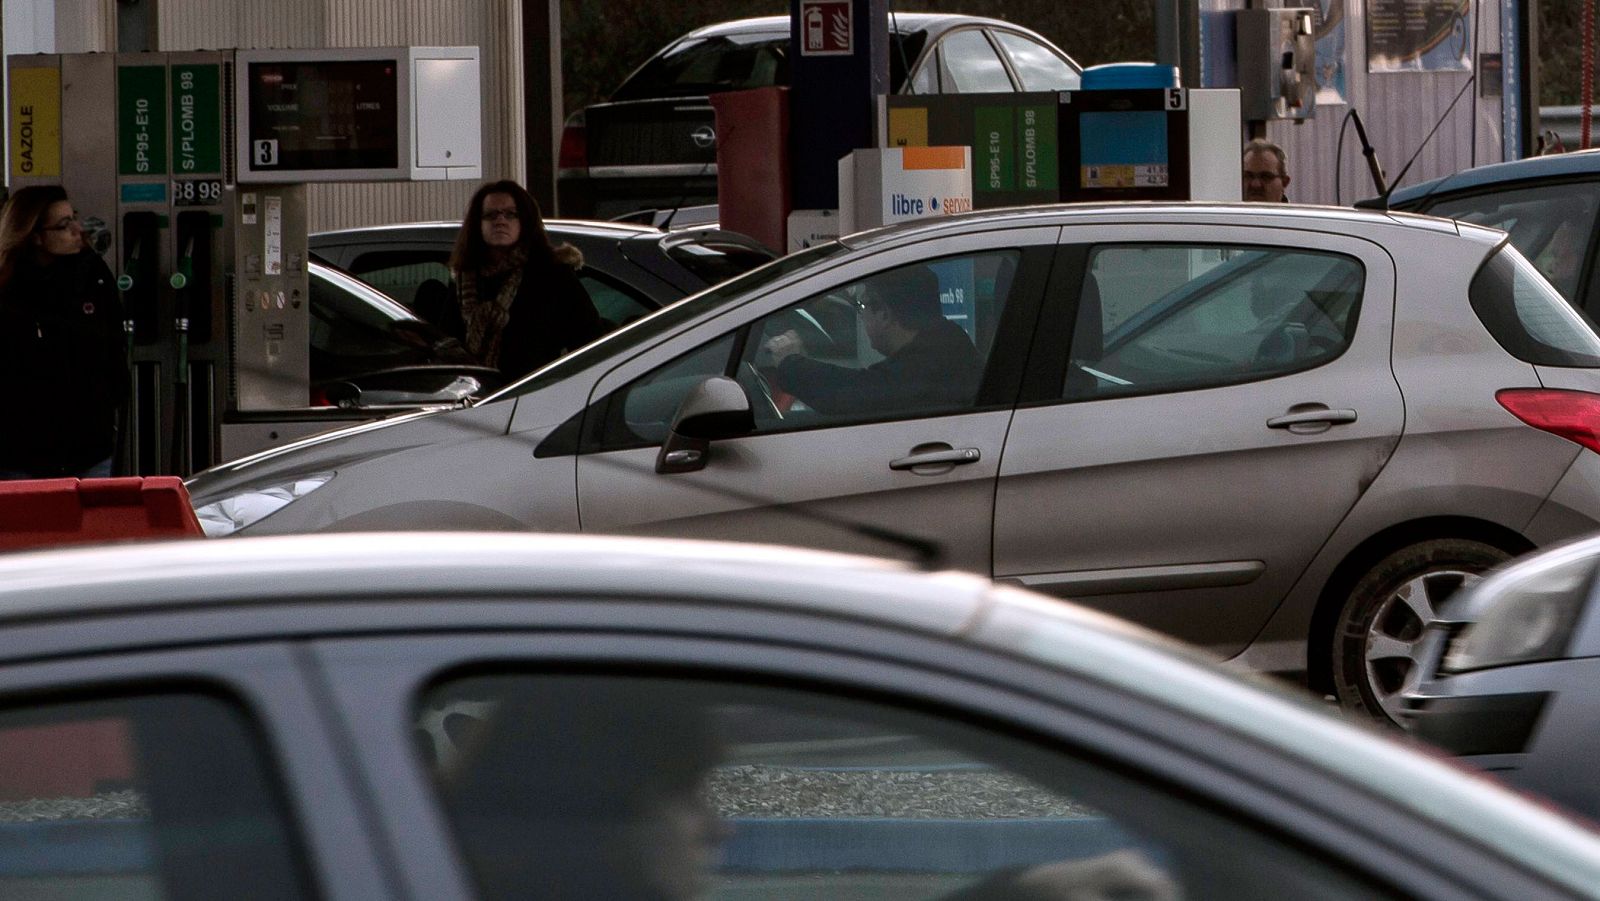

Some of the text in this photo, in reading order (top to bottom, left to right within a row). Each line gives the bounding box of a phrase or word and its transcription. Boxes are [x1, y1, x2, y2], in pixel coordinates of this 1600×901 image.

[181, 71, 195, 170] S/PLOMB 98
[1169, 89, 1182, 109] 5
[20, 105, 33, 173] GAZOLE
[136, 99, 149, 172] SP95-E10
[260, 141, 272, 163] 3
[990, 131, 1000, 189] SP95-E10
[1025, 110, 1037, 188] S/PLOMB 98
[198, 182, 221, 199] 98
[892, 194, 924, 215] libre
